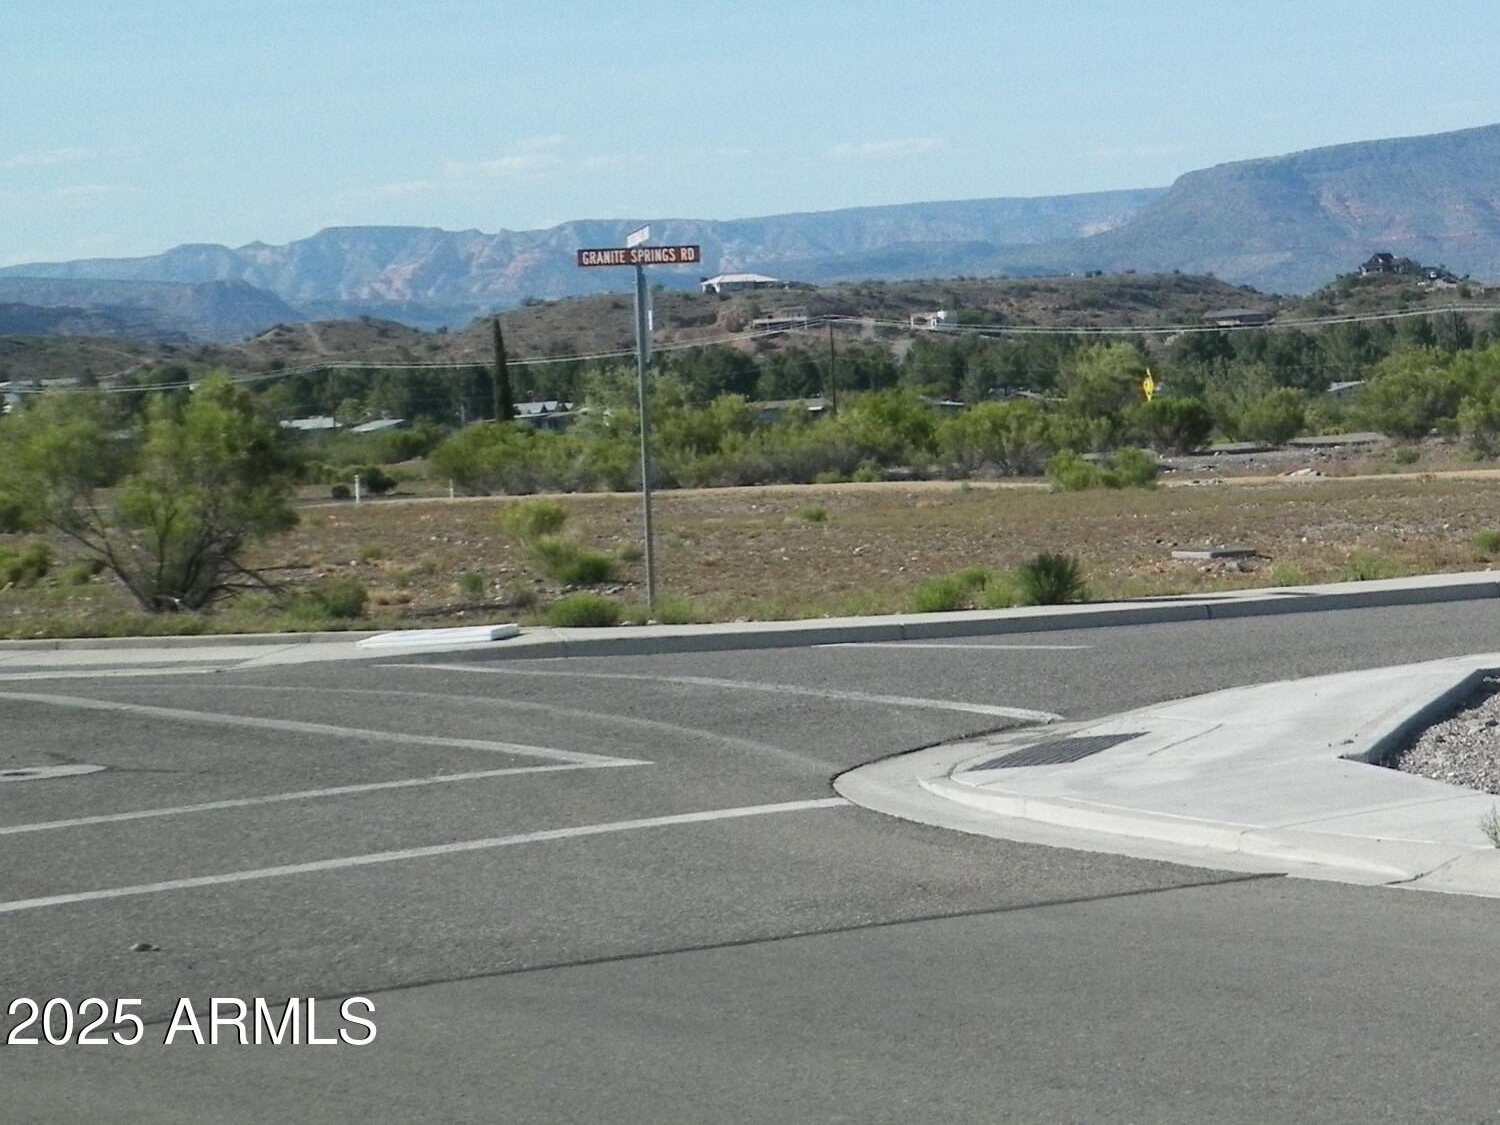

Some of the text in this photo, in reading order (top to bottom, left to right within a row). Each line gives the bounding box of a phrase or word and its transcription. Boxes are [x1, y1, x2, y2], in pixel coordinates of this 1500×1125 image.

[582, 247, 695, 265] GRANITE SPRINGS RD
